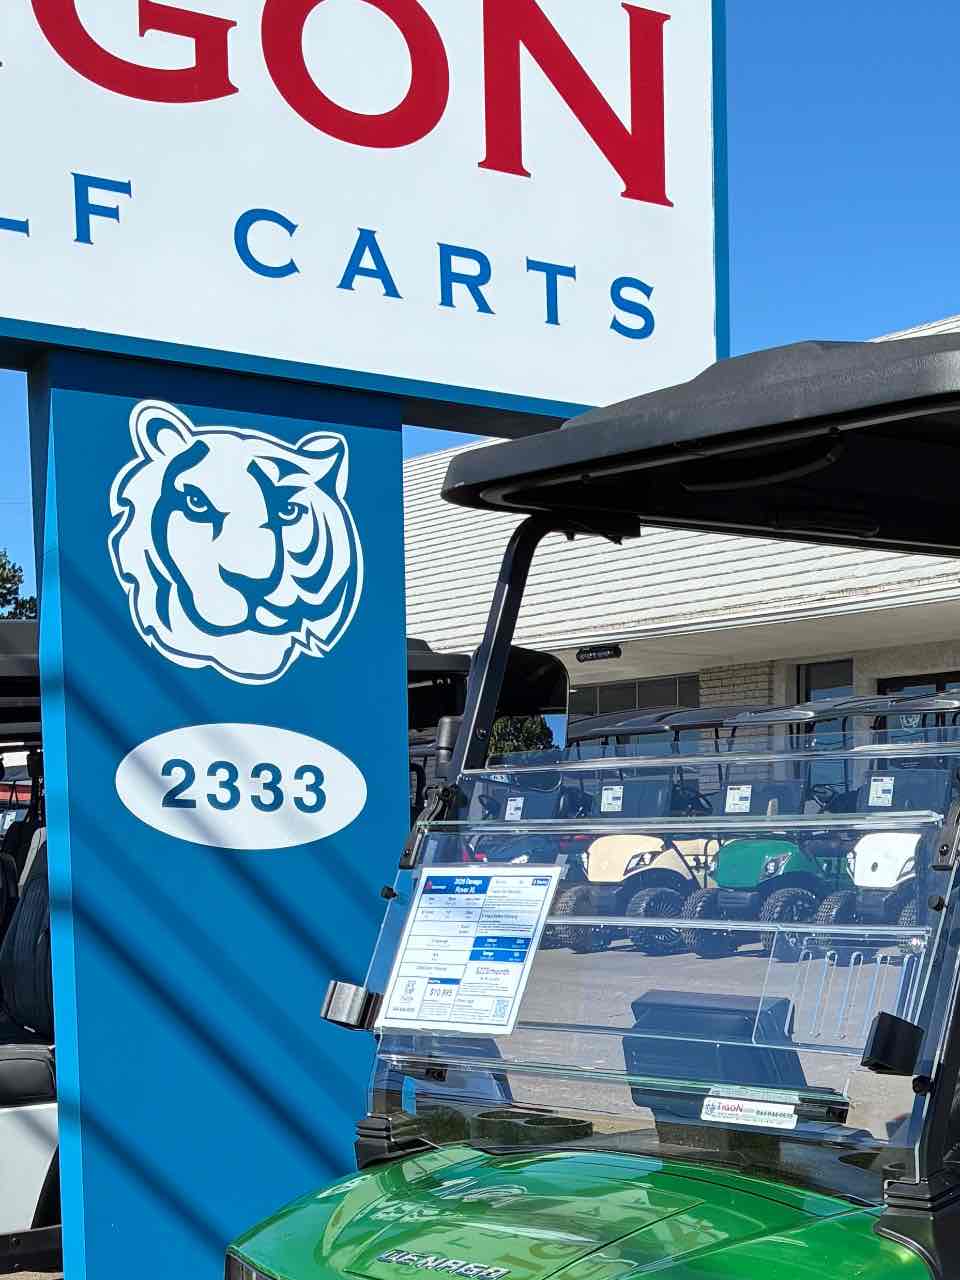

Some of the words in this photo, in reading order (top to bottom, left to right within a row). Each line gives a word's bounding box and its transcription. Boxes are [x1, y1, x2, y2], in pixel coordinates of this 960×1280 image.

[0, 172, 132, 245] F
[233, 208, 656, 340] CARTS
[161, 758, 327, 814] 2333
